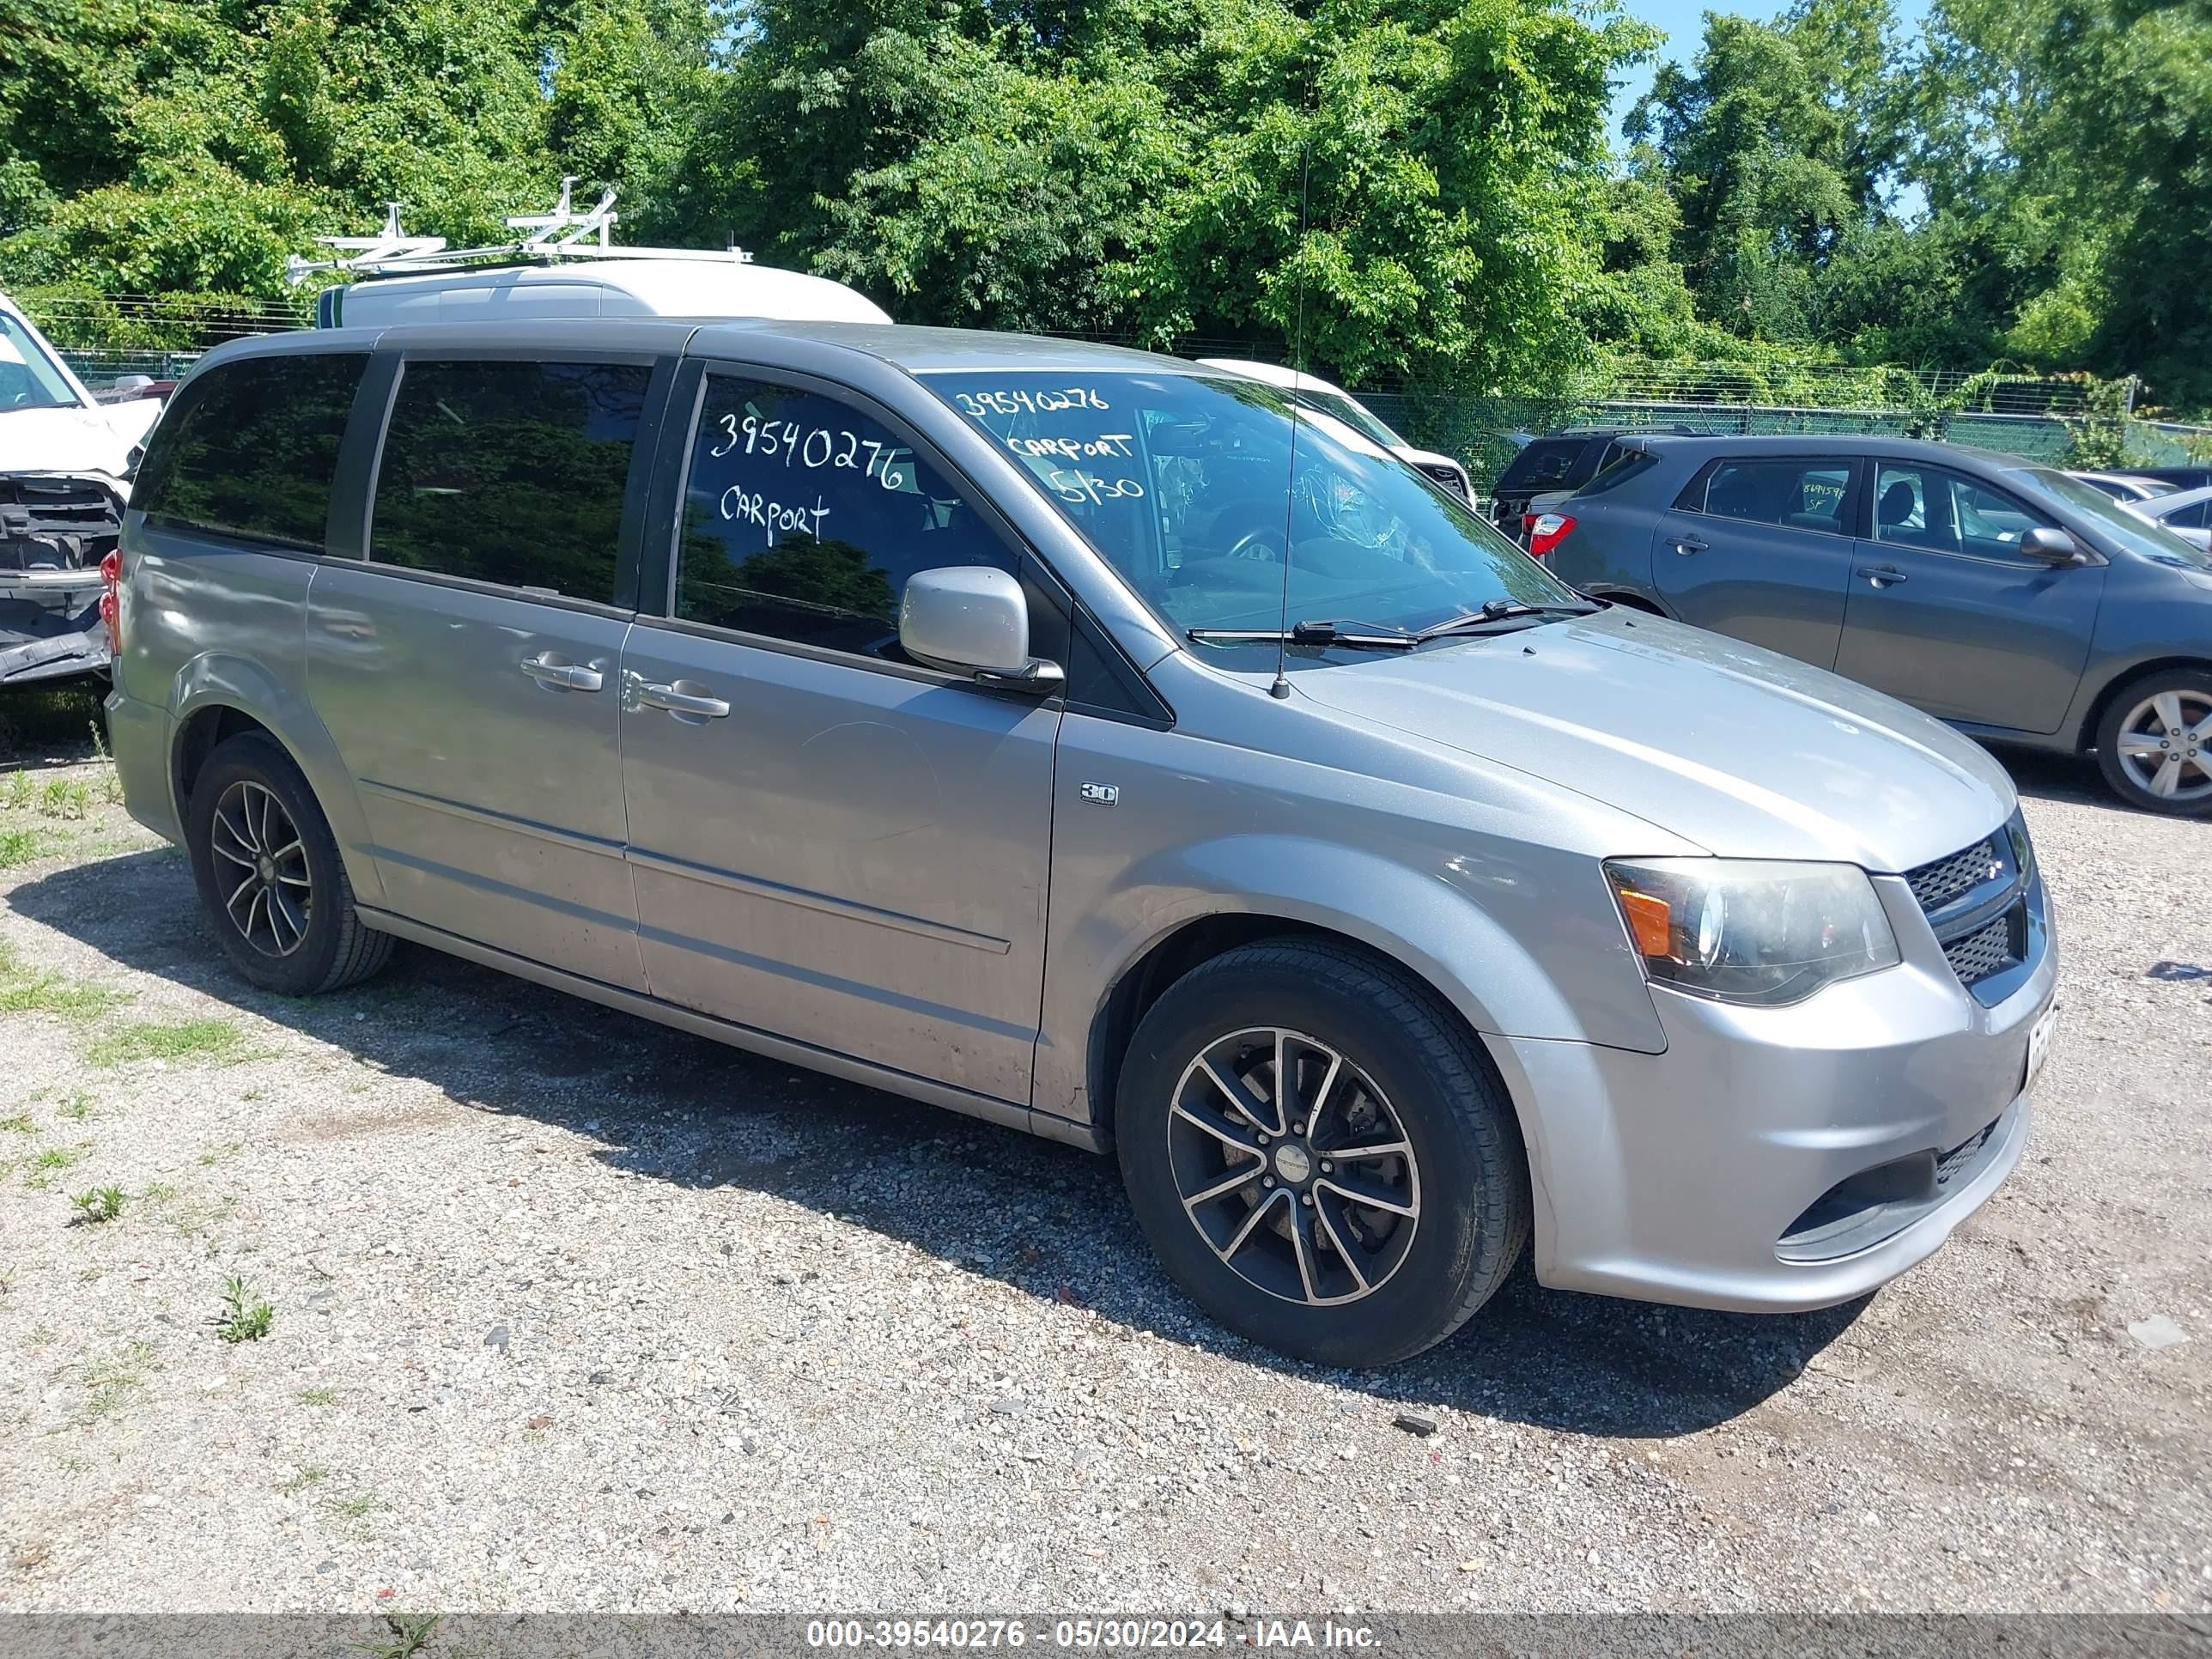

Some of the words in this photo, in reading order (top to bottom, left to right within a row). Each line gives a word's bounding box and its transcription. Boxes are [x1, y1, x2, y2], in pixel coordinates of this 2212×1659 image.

[955, 388, 1110, 416] 39540276
[710, 413, 903, 490] 39540276
[1006, 434, 1133, 461] CARPORT
[1048, 468, 1145, 506] 5/30
[1081, 783, 1115, 801] 30
